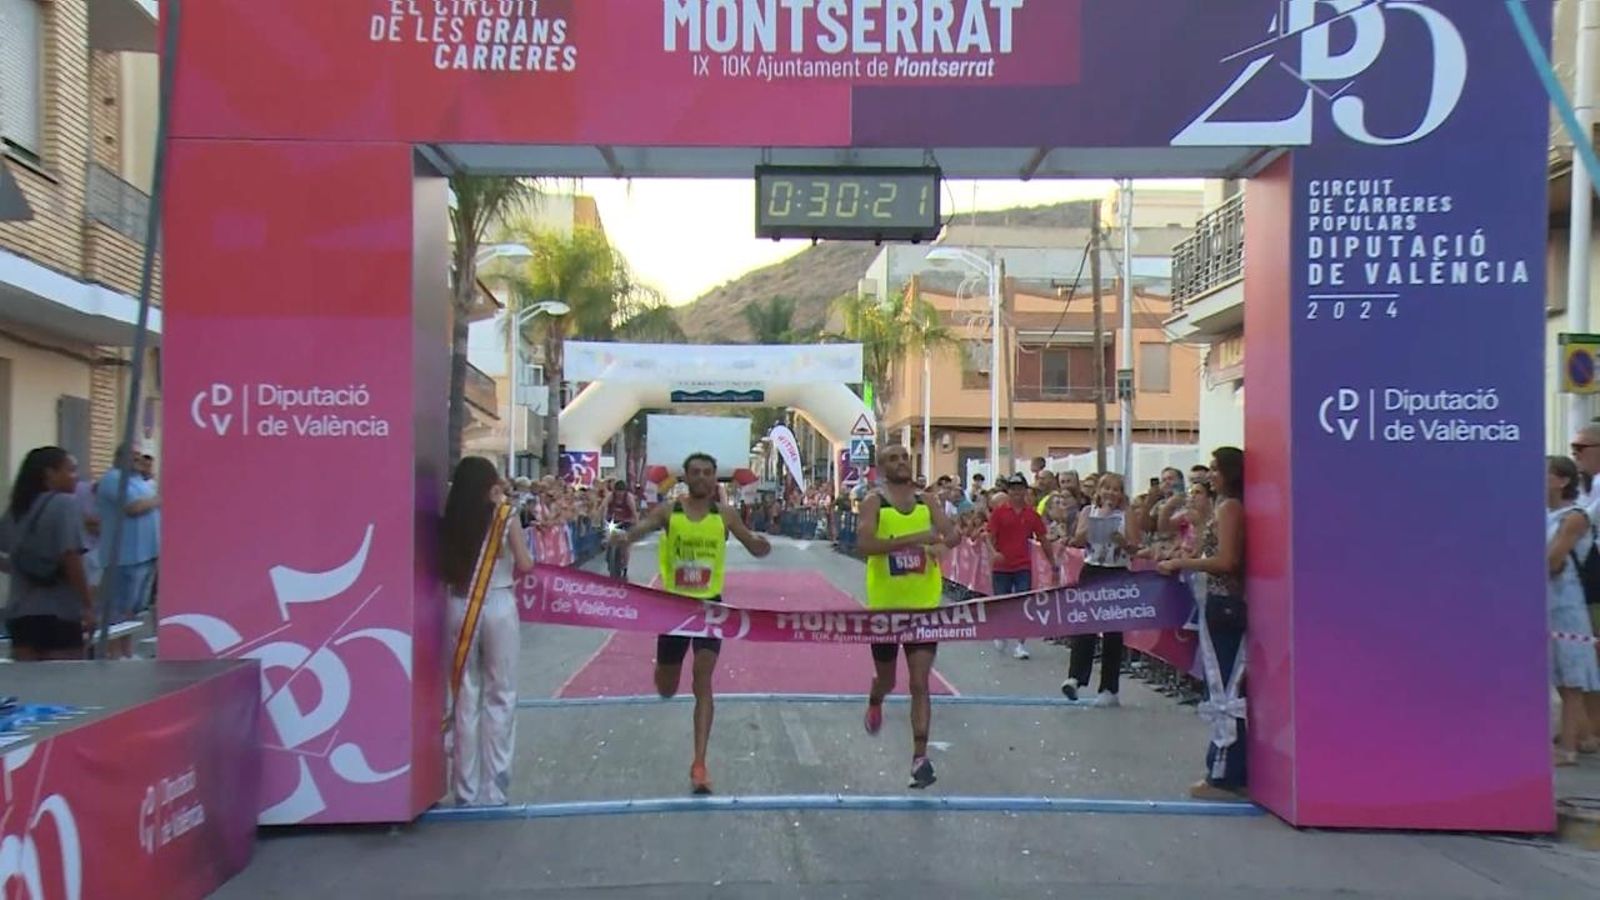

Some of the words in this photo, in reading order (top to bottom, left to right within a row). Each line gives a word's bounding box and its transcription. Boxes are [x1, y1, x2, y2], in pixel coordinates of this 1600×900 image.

[370, 16, 404, 42] DE
[416, 16, 464, 43] LES
[476, 19, 567, 44] GRANS
[663, 0, 1024, 53] MONTSERRAT
[434, 44, 577, 71] CARRERES
[692, 56, 710, 76] IX
[721, 56, 751, 76] 10K
[757, 57, 861, 81] Ajuntament
[867, 57, 888, 77] de
[894, 57, 995, 77] Montserrat
[768, 181, 928, 218] 0:30:21
[1309, 180, 1394, 196] CIRCUIT
[1309, 198, 1333, 214] DE
[1344, 197, 1453, 213] CARRERES
[1309, 215, 1417, 231] POPULARS
[1308, 229, 1487, 259] DIPUTACIÓ
[1308, 263, 1345, 285] DE
[1365, 257, 1529, 285] VALÈNCIA
[258, 384, 370, 410] Diputació
[1384, 388, 1499, 415] Diputació
[257, 415, 288, 436] de
[292, 415, 389, 436] València
[1384, 419, 1415, 441] de
[1419, 418, 1520, 441] València
[553, 577, 628, 600] Diputació
[1065, 584, 1140, 606] Diputació
[551, 600, 571, 614] de
[575, 599, 638, 620] València
[1067, 609, 1087, 624] de
[1089, 604, 1156, 622] València
[916, 624, 977, 639] Montserrat
